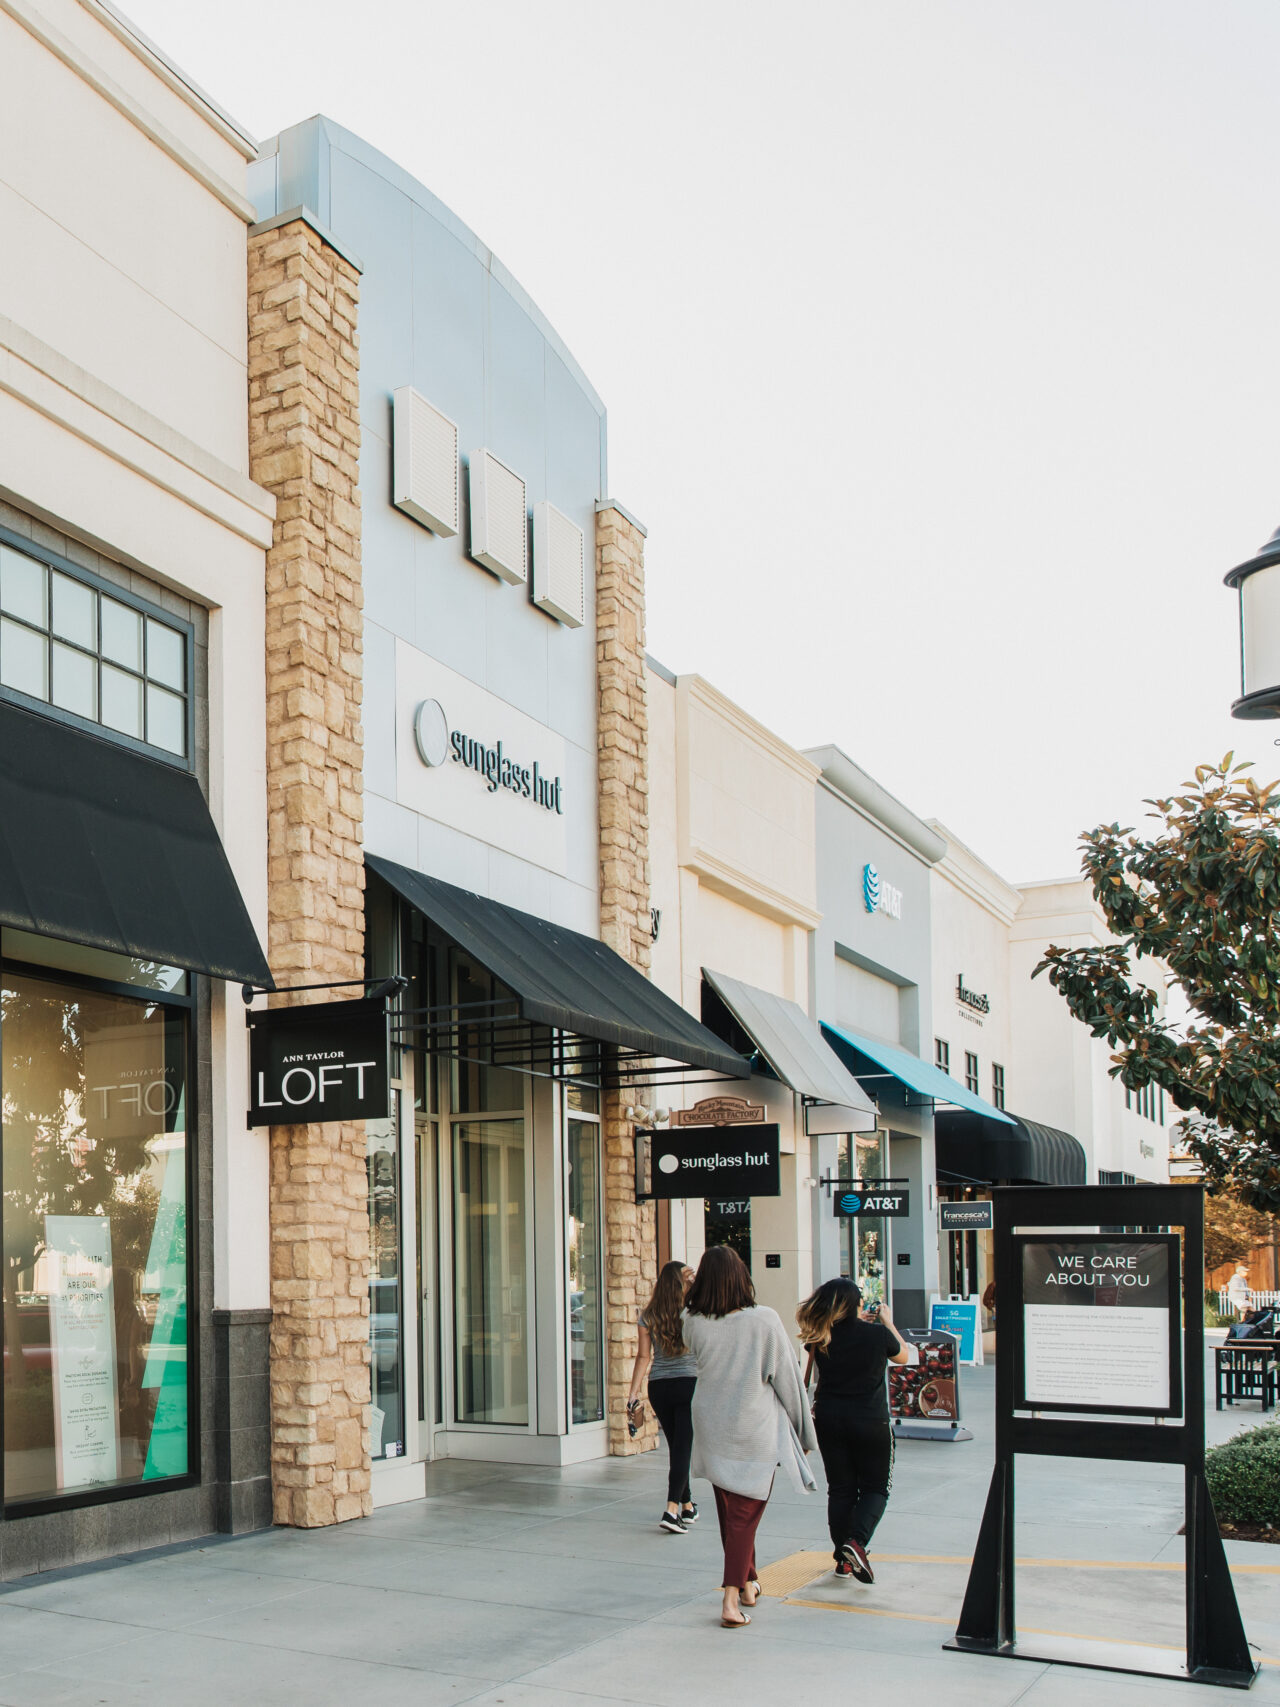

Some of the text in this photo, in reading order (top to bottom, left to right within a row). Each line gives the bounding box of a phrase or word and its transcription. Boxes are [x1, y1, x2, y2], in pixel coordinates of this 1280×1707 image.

[451, 730, 563, 815] sunglass hut
[283, 1051, 345, 1063] ANN TAYLOR
[258, 1061, 377, 1107] LOFT
[683, 1110, 760, 1122] CHOCOLATE FACTORY
[682, 1152, 770, 1171] sunglass hut
[863, 1197, 902, 1210] AT&T
[944, 1210, 989, 1220] francesca's
[1058, 1256, 1137, 1269] WE CARE
[1045, 1273, 1150, 1287] ABOUT YOU
